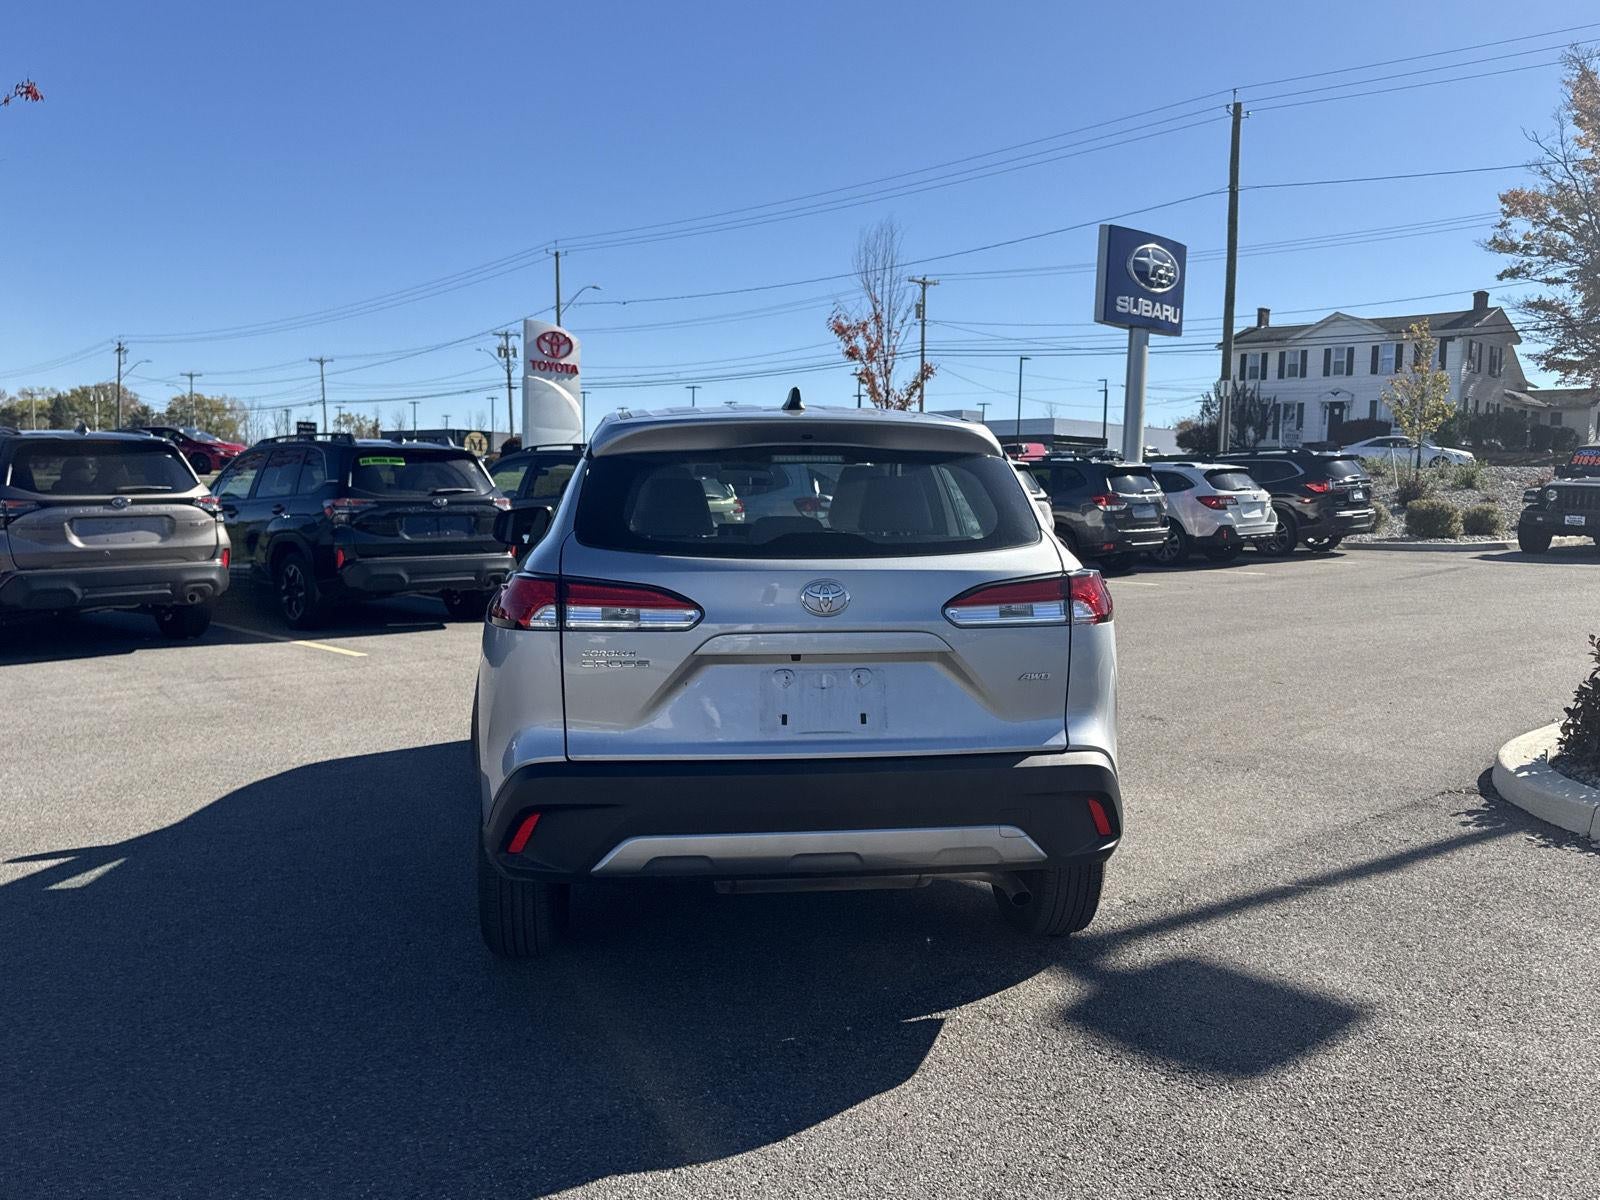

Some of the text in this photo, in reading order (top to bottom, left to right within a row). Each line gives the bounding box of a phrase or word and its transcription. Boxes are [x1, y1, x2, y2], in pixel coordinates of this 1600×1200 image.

[1116, 295, 1180, 324] SUBARU
[529, 359, 579, 375] TOYOTA
[582, 649, 636, 657] COROLLA
[582, 660, 650, 668] CROSS
[1018, 672, 1050, 681] AWD
